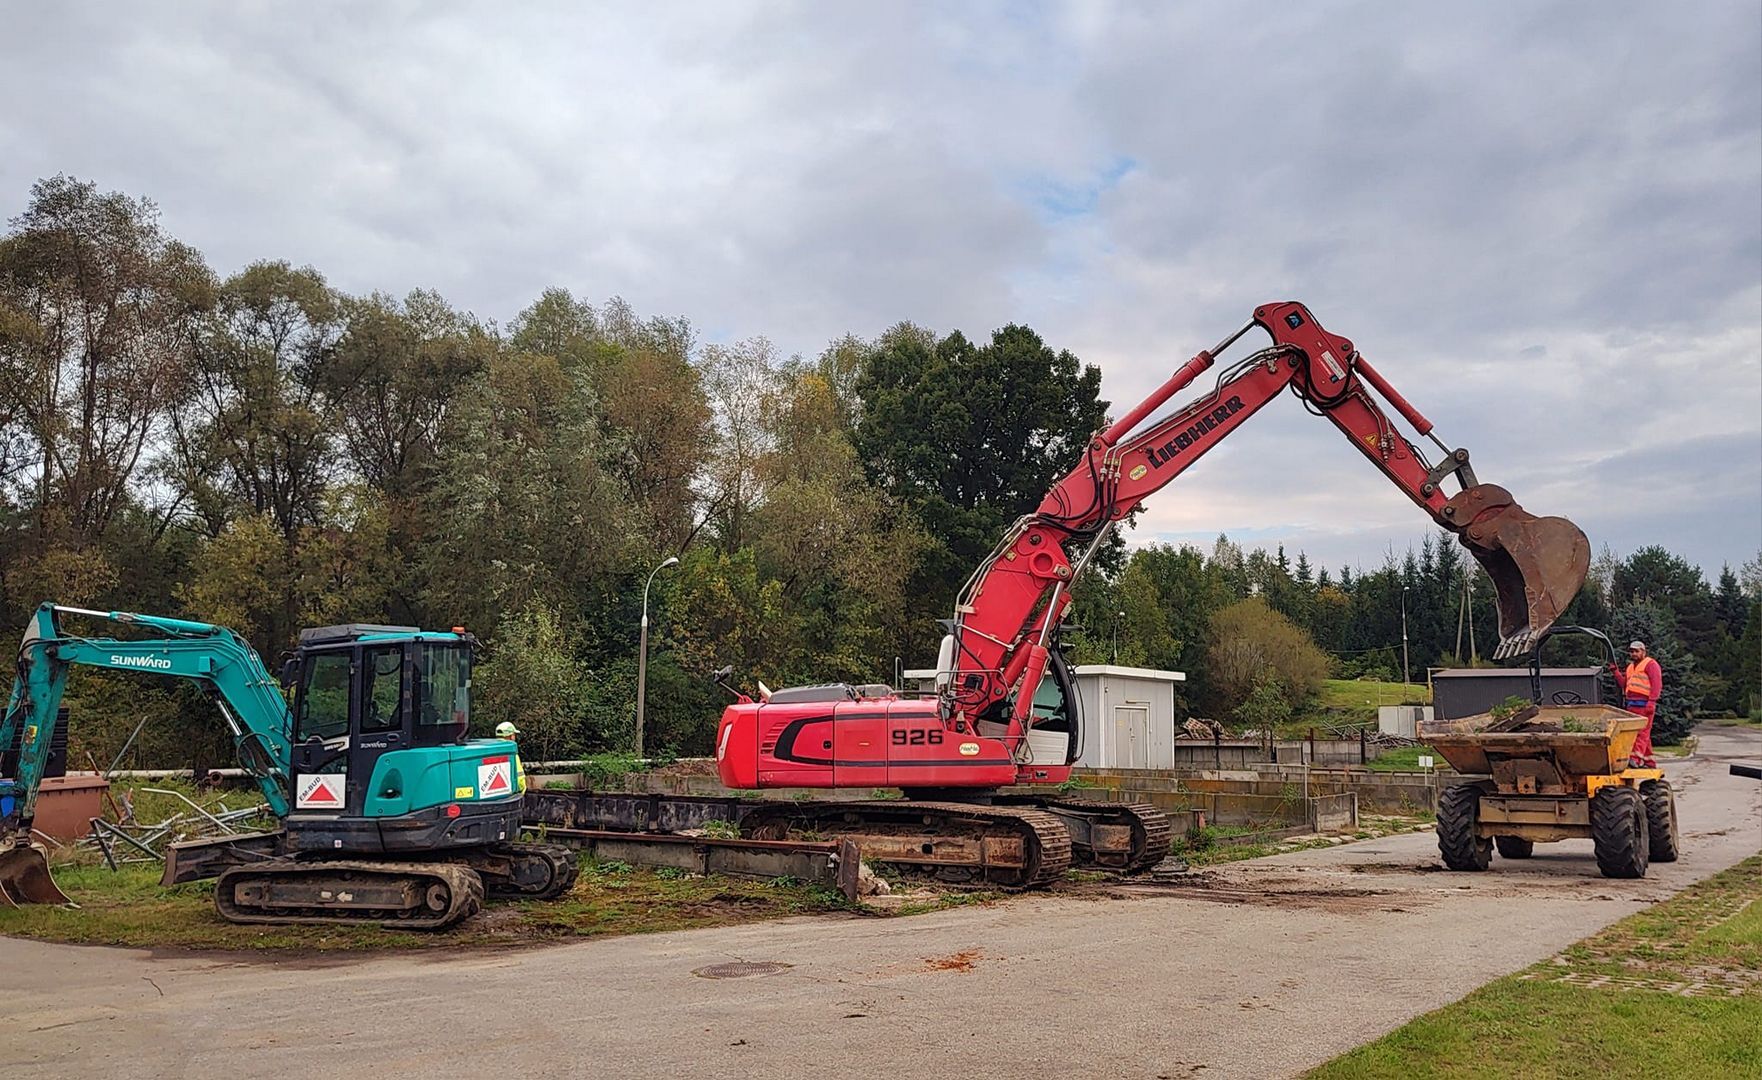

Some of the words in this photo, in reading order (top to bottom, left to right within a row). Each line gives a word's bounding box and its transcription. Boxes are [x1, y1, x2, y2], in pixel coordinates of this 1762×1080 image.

[1146, 395, 1246, 470] LIEBHERR
[110, 653, 171, 669] SUNWARD
[892, 729, 943, 746] 926
[298, 776, 321, 802] EM-BUD
[479, 765, 498, 793] EM-BUD
